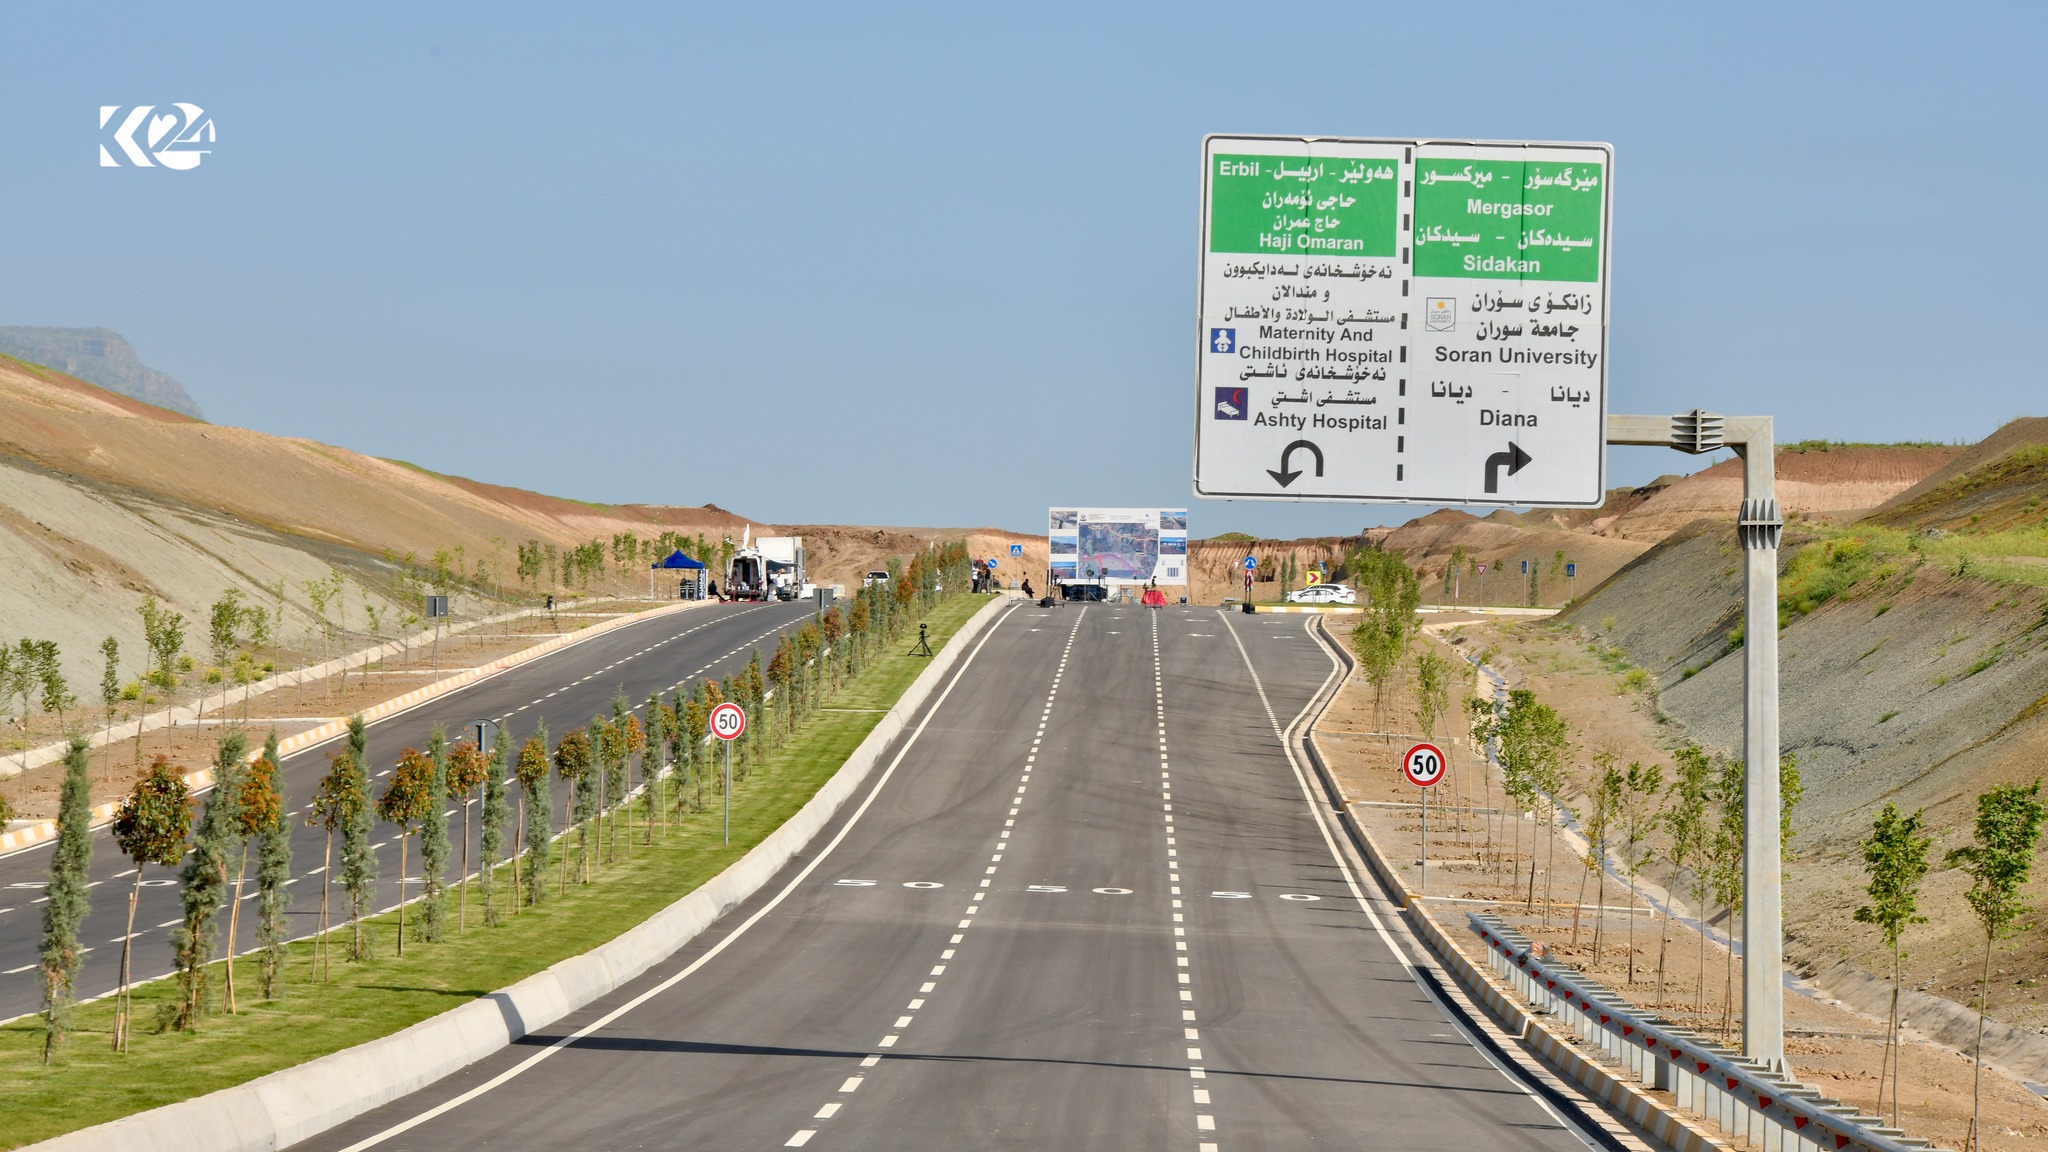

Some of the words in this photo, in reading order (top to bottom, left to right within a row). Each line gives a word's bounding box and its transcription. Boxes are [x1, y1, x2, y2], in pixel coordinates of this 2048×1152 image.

[1219, 161, 1259, 176] Erbil
[1467, 198, 1554, 219] Mergasor
[1272, 214, 1311, 231] عمران
[1314, 215, 1341, 232] حاج
[1259, 233, 1292, 251] Haji
[1297, 234, 1364, 250] Omaran
[1463, 254, 1541, 273] Sidakan
[1259, 325, 1335, 344] Maternity
[1340, 328, 1373, 341] And
[1530, 319, 1579, 342] جامعة
[1239, 345, 1320, 361] Childbirth
[1326, 348, 1392, 366] Hospital
[1435, 346, 1492, 362] Soran
[1499, 347, 1597, 369] University
[1254, 412, 1307, 431] Ashty
[1313, 414, 1387, 432] Hospital
[1480, 409, 1538, 427] Diana
[719, 713, 738, 730] 50
[1412, 754, 1437, 775] 50
